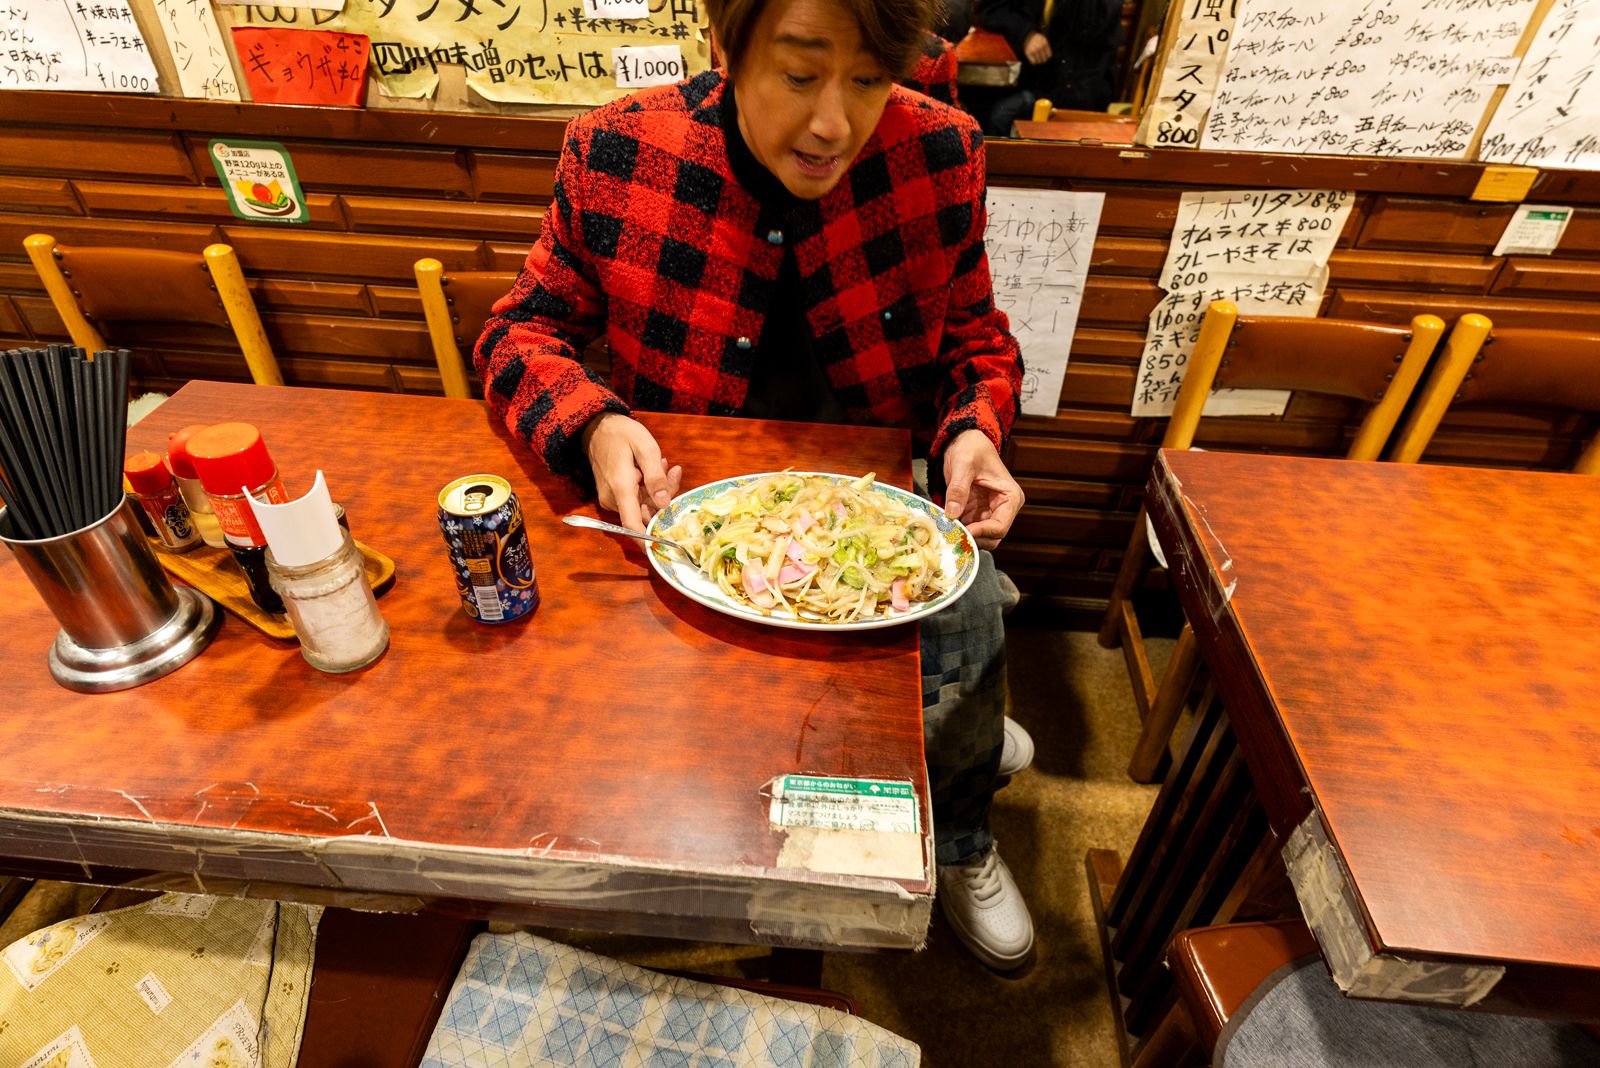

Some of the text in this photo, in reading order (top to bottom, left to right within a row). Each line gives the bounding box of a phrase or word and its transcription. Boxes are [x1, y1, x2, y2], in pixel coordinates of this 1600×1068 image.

[371, 39, 608, 84] 四川味噌のセットは
[95, 63, 149, 91] ¥1000
[201, 77, 236, 98] ¥950
[1156, 121, 1198, 144] 800
[224, 160, 283, 170] 野菜120g以上の
[229, 169, 286, 179] メニューがある店
[1186, 192, 1312, 222] ナポリタン
[1181, 217, 1333, 249] オムライス ¥800
[1170, 271, 1208, 290] 800
[1145, 354, 1187, 370] 850
[79, 924, 98, 941] Bear
